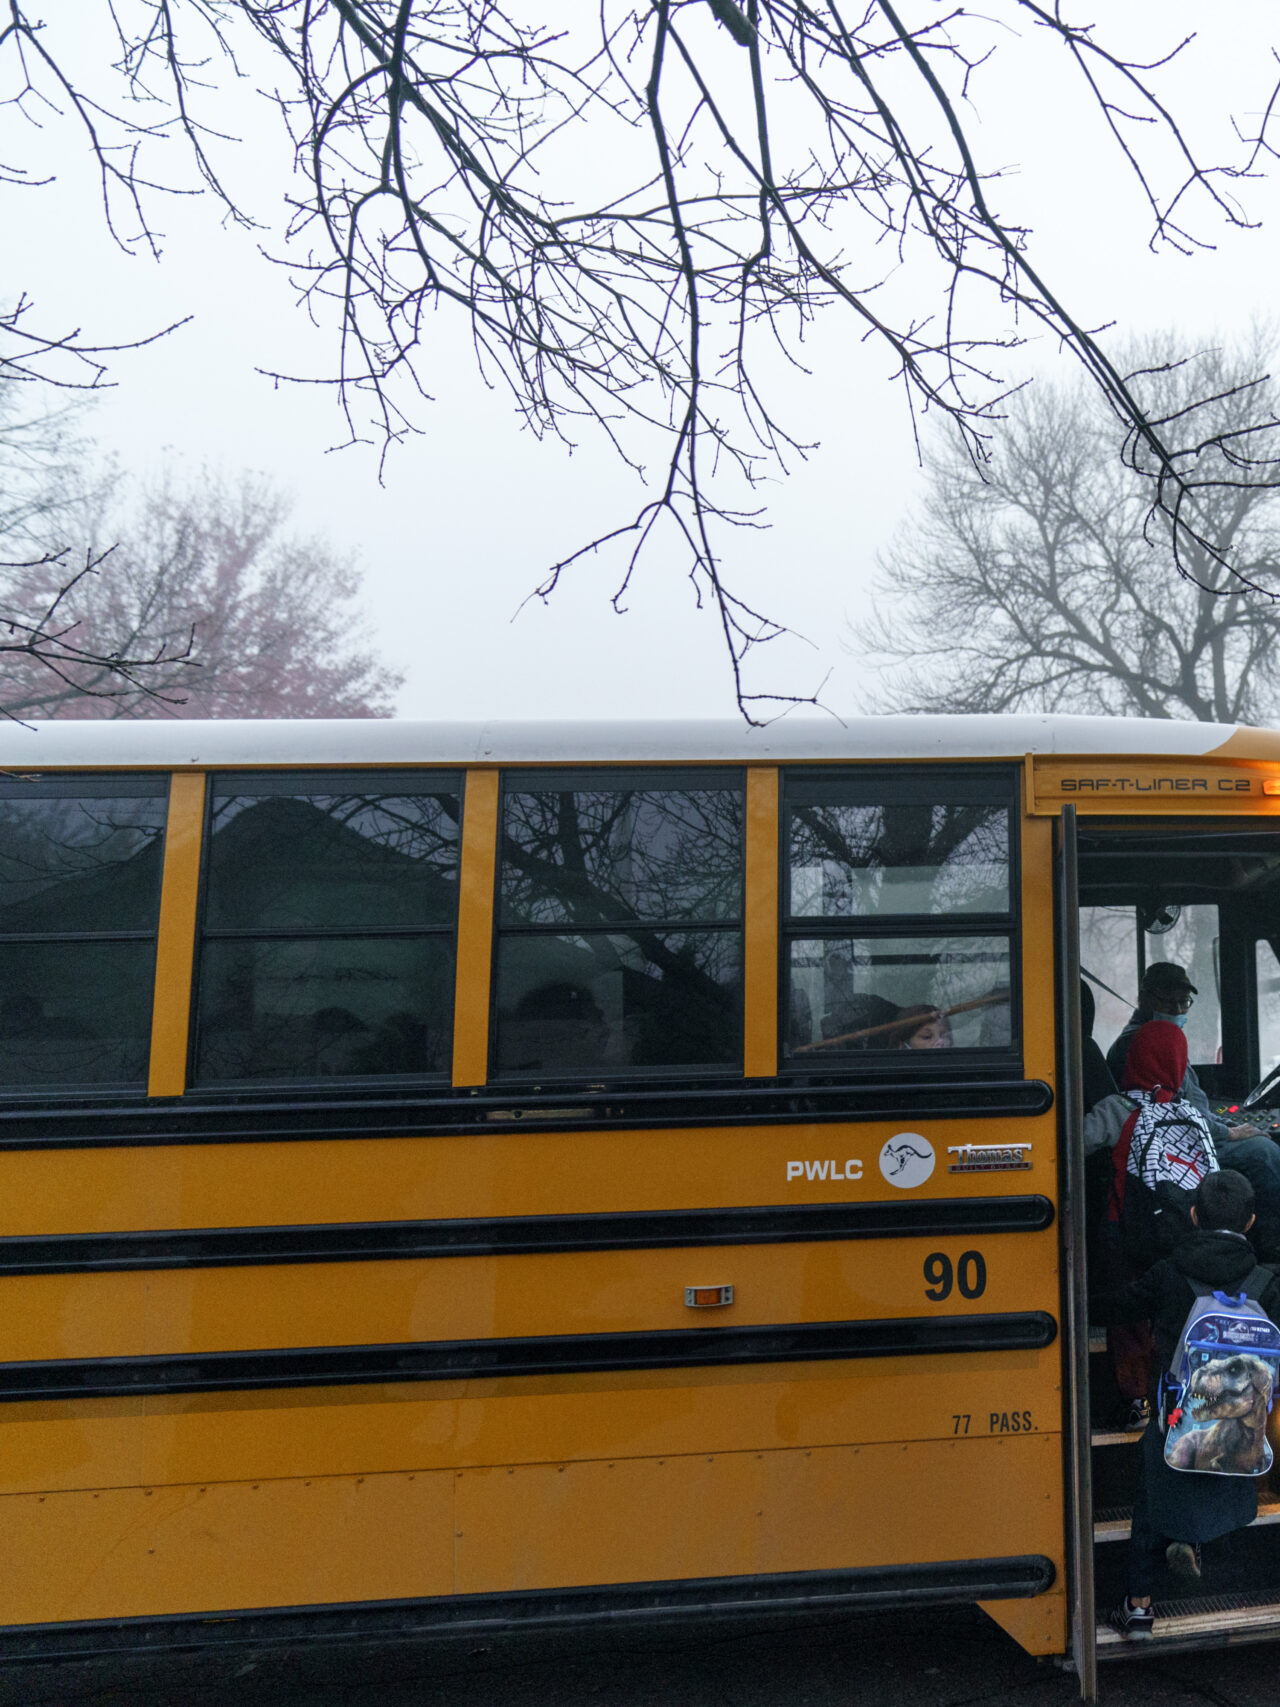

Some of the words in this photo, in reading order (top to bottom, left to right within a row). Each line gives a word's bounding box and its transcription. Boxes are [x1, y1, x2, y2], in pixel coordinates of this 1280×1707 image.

[1060, 778, 1208, 792] SAF-T-LINER
[1217, 779, 1252, 792] C2
[947, 1143, 1032, 1165] Thomas
[786, 1159, 864, 1182] PWLC
[923, 1250, 987, 1302] 90
[952, 1414, 972, 1435] 77
[989, 1411, 1039, 1433] PASS.
